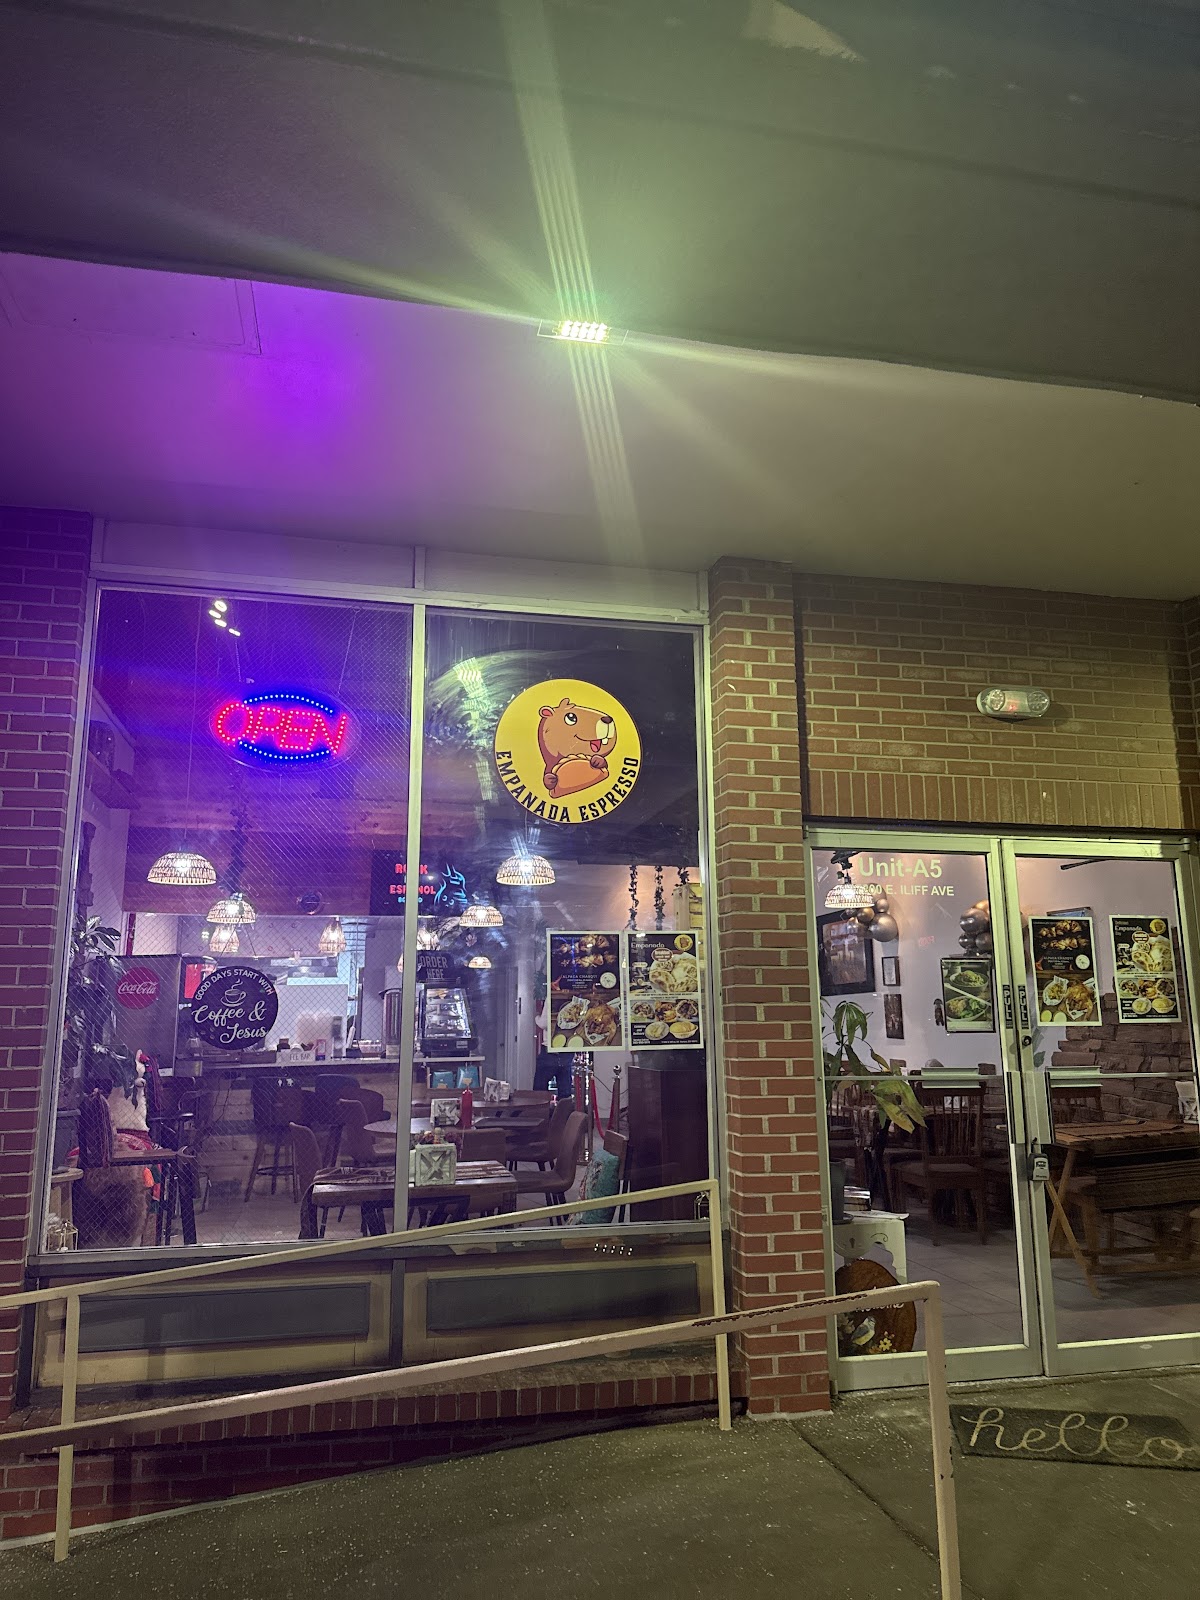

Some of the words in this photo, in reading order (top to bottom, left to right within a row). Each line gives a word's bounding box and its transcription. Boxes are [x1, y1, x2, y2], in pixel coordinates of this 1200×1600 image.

[216, 702, 347, 757] OPEN
[496, 750, 571, 822] EMPANADA
[578, 757, 639, 822] ESPRESSO
[395, 863, 428, 874] RK
[858, 857, 943, 878] Unit-A5
[886, 884, 897, 895] E.
[900, 885, 928, 896] ILIFF
[931, 886, 955, 896] AVE
[420, 955, 448, 968] ORDER
[195, 980, 211, 1001] GOOD
[211, 970, 232, 983] DAYS
[233, 968, 259, 980] START
[258, 977, 275, 996] WITH
[191, 1005, 245, 1027] Coffee
[248, 1000, 267, 1022] &
[1004, 990, 1012, 1020] PULL
[1019, 990, 1028, 1020] PULL
[220, 1023, 268, 1043] Jesus
[960, 1407, 1191, 1462] hello
